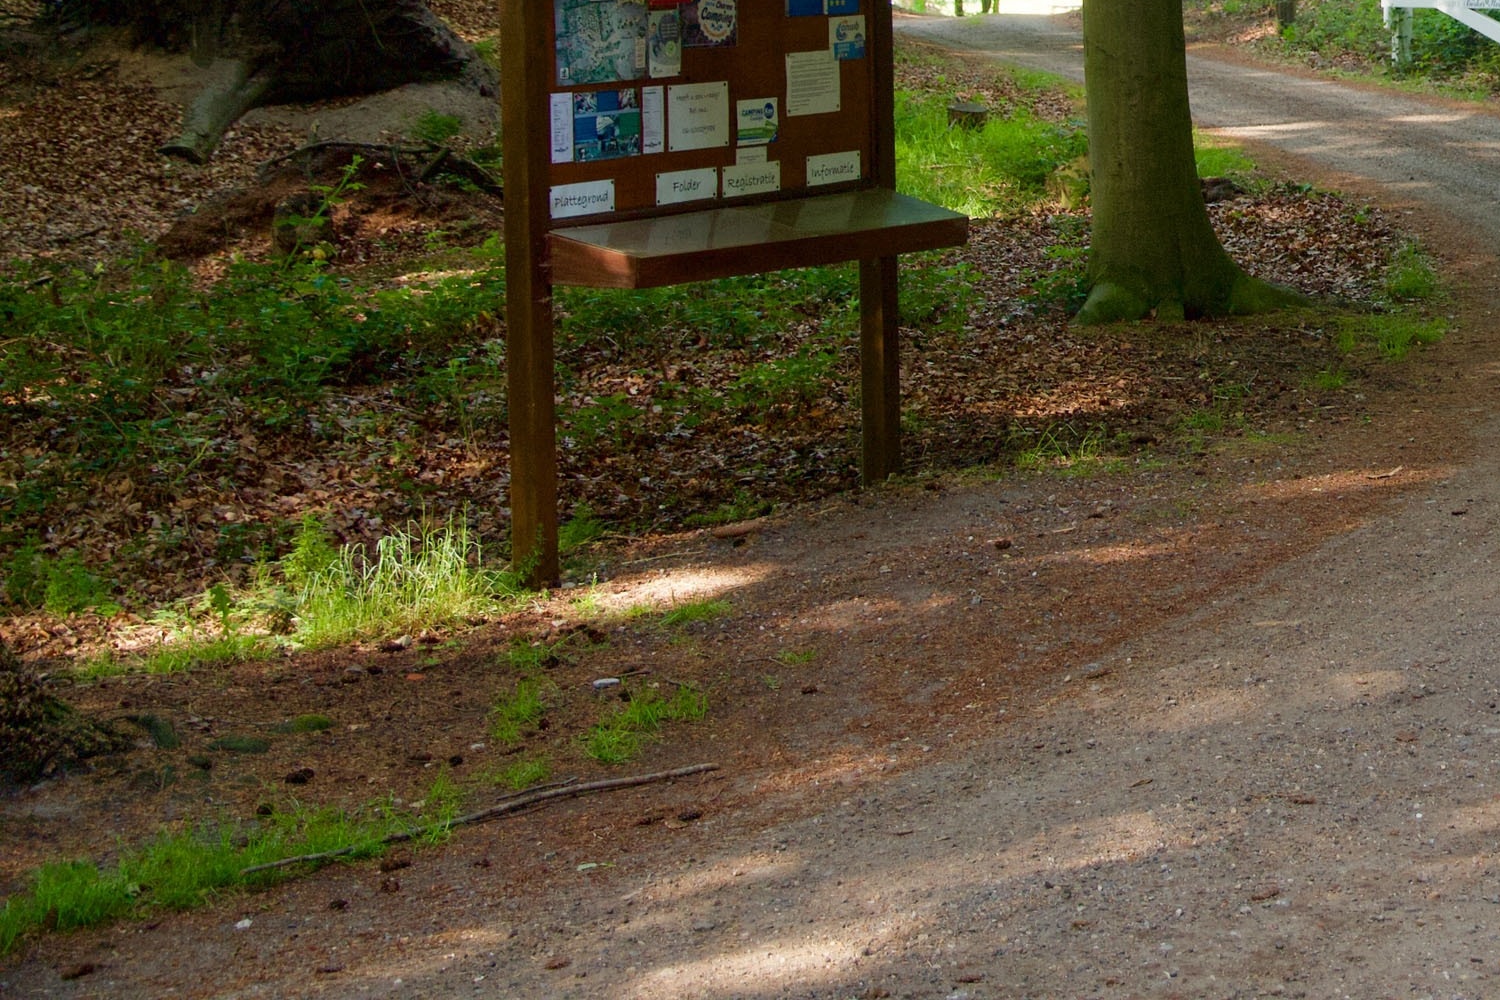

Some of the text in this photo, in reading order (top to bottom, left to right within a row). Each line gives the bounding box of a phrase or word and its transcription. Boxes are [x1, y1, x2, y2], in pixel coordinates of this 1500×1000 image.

[701, 7, 733, 27] Camping
[742, 108, 763, 116] CAMPING
[811, 162, 855, 180] Informatie
[673, 179, 701, 192] Folder
[728, 172, 776, 191] Registratie
[554, 191, 609, 208] Plattegrond
